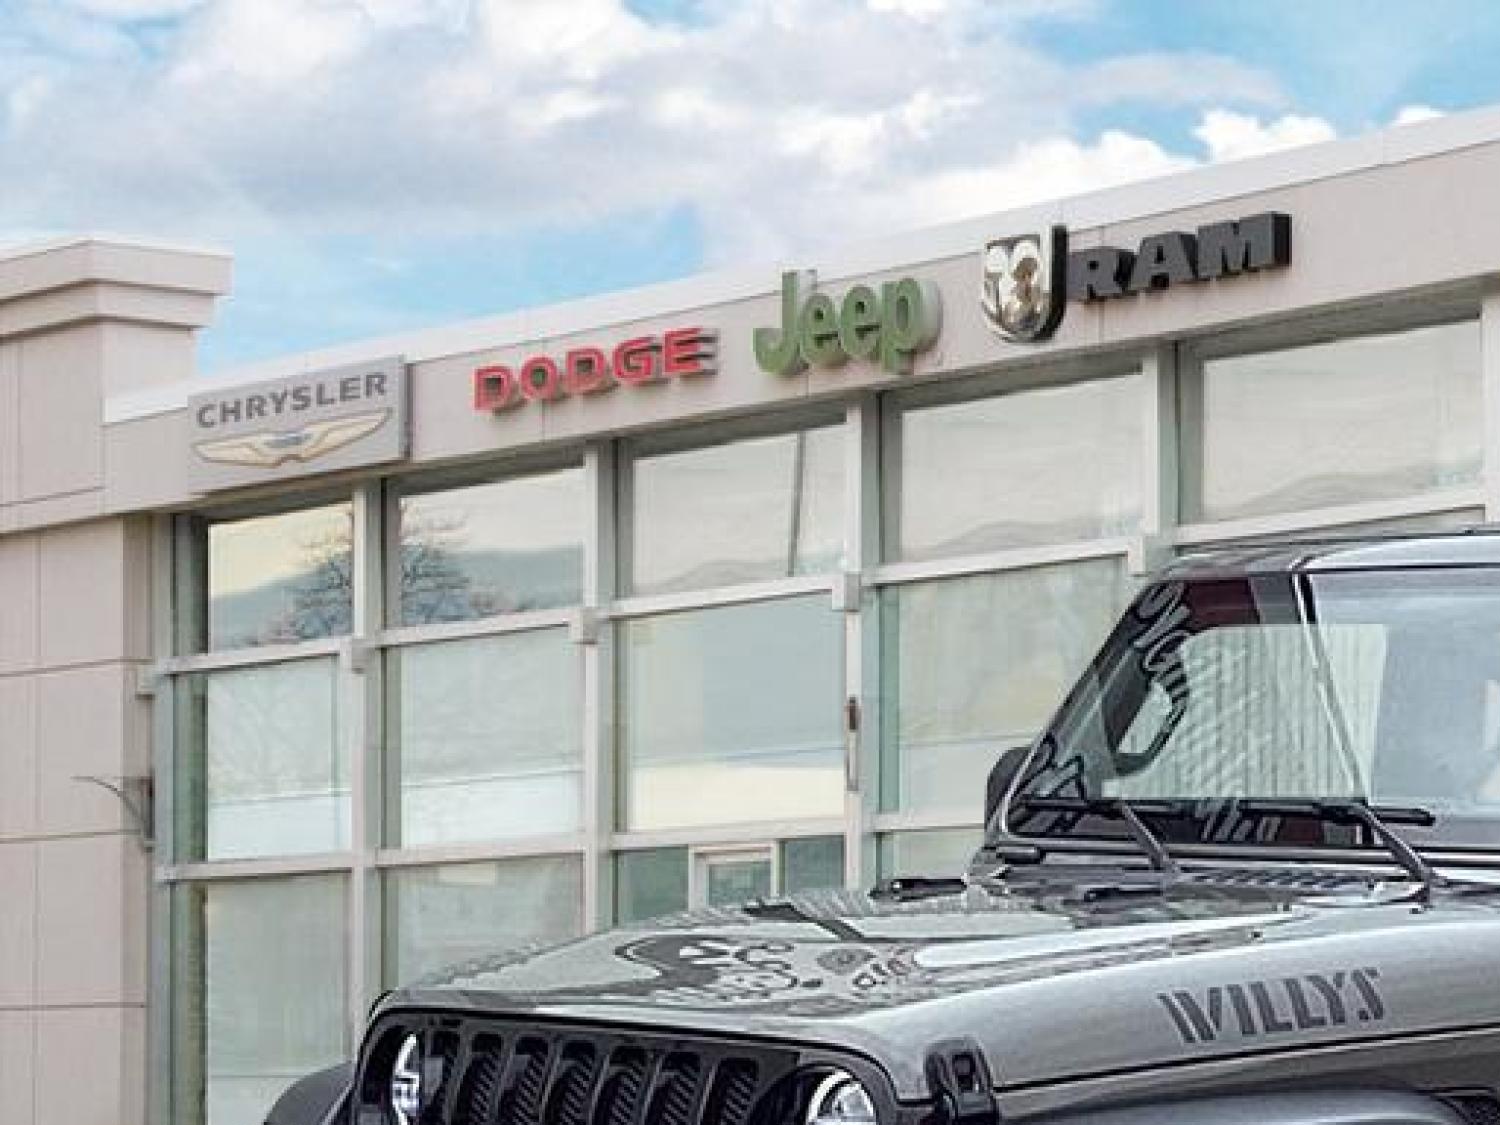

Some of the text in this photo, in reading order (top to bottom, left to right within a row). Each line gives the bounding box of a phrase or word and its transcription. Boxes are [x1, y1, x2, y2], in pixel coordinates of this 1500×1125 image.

[1067, 210, 1292, 303] RAM
[753, 269, 938, 377] Jeep
[196, 372, 389, 429] CHRYSLER
[473, 327, 714, 412] DODGE
[1156, 966, 1385, 1044] WILLYS
